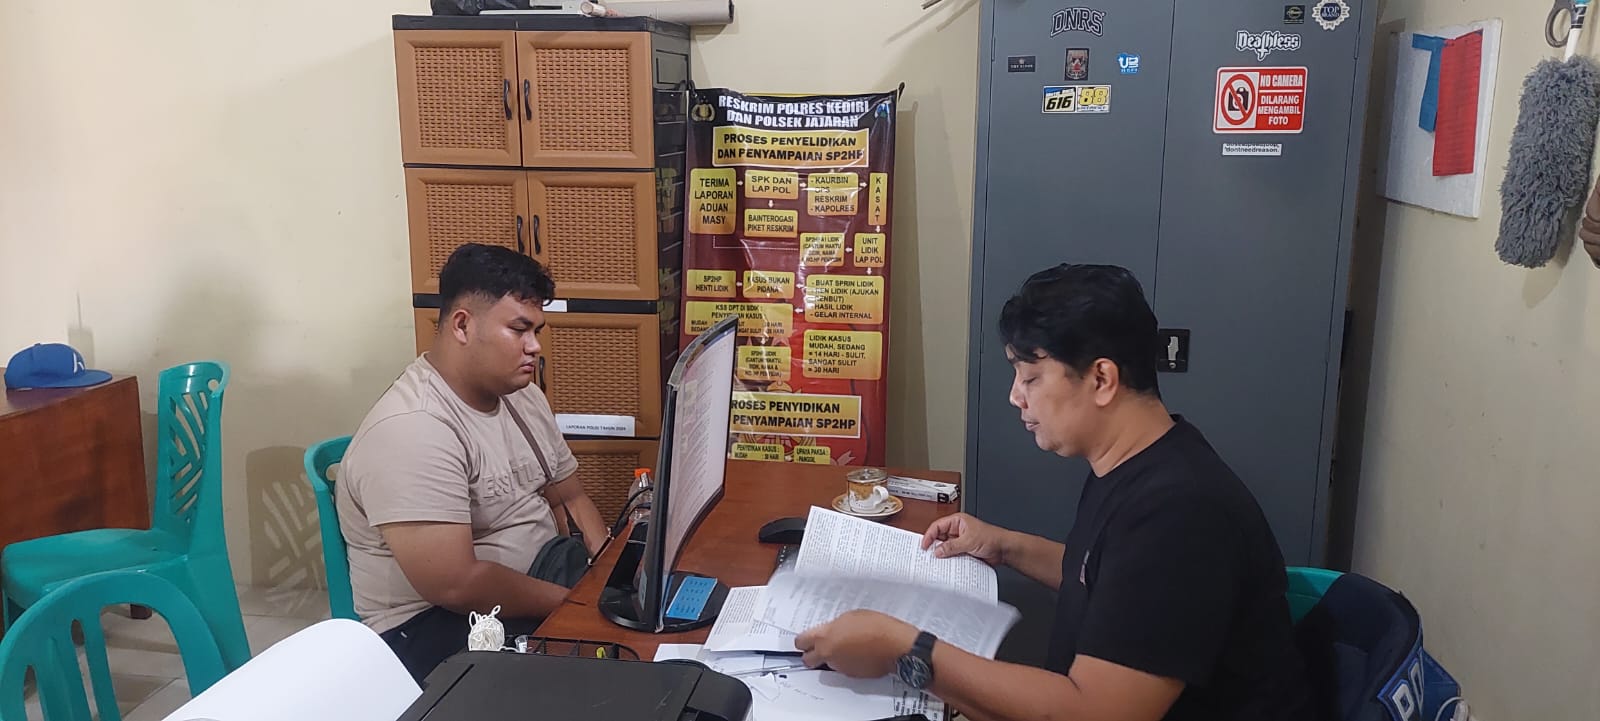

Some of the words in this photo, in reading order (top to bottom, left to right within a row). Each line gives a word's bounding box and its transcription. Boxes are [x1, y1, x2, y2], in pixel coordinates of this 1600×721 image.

[1051, 7, 1104, 38] DNRS
[1237, 31, 1300, 60] Deathless
[1260, 75, 1271, 87] NO
[1272, 75, 1304, 87] CAMERA
[1079, 87, 1109, 106] 88
[1260, 95, 1300, 105] DILARANG
[718, 95, 774, 114] RESKRIM
[777, 99, 824, 115] POLRES
[826, 99, 869, 114] KEDIRI
[1046, 96, 1074, 110] 616
[1257, 106, 1301, 114] MENGAMBIL
[726, 110, 753, 126] DAN
[754, 114, 802, 128] POLSEK
[804, 114, 859, 128] JAJARAN
[1268, 116, 1289, 125] FOTO
[723, 133, 768, 145] PROSES
[771, 136, 857, 147] PENYELIDIKAN
[717, 148, 736, 159] DAN
[738, 148, 823, 161] PENYAMPAIAN
[826, 150, 864, 161] SP2HP
[700, 178, 730, 188] TERIMA
[772, 176, 792, 184] DAN
[815, 176, 848, 184] KAURBIN
[752, 185, 770, 193] LAP
[772, 186, 791, 194] POL
[694, 190, 734, 200] LAPORAN
[699, 202, 728, 212] ADUAN
[814, 204, 854, 212] KAPOLRES
[702, 216, 726, 224] MASY
[748, 214, 794, 223] BAINTEROGASI
[747, 223, 765, 232] PIKET
[766, 224, 794, 232] RESKRIM
[862, 237, 878, 245] UNIT
[861, 246, 878, 254] LIDIK
[870, 256, 883, 264] POL
[748, 276, 766, 284] KASUS
[768, 276, 790, 284] BUKAN
[696, 284, 712, 292] HENTI
[850, 288, 879, 296] (AJUKAN
[809, 342, 836, 350] MUDAH,
[731, 400, 766, 410] ROSES
[768, 402, 840, 414] PENYIDIKAN
[732, 414, 814, 428] PENYAMPAIAN
[816, 418, 857, 430] SP2HP
